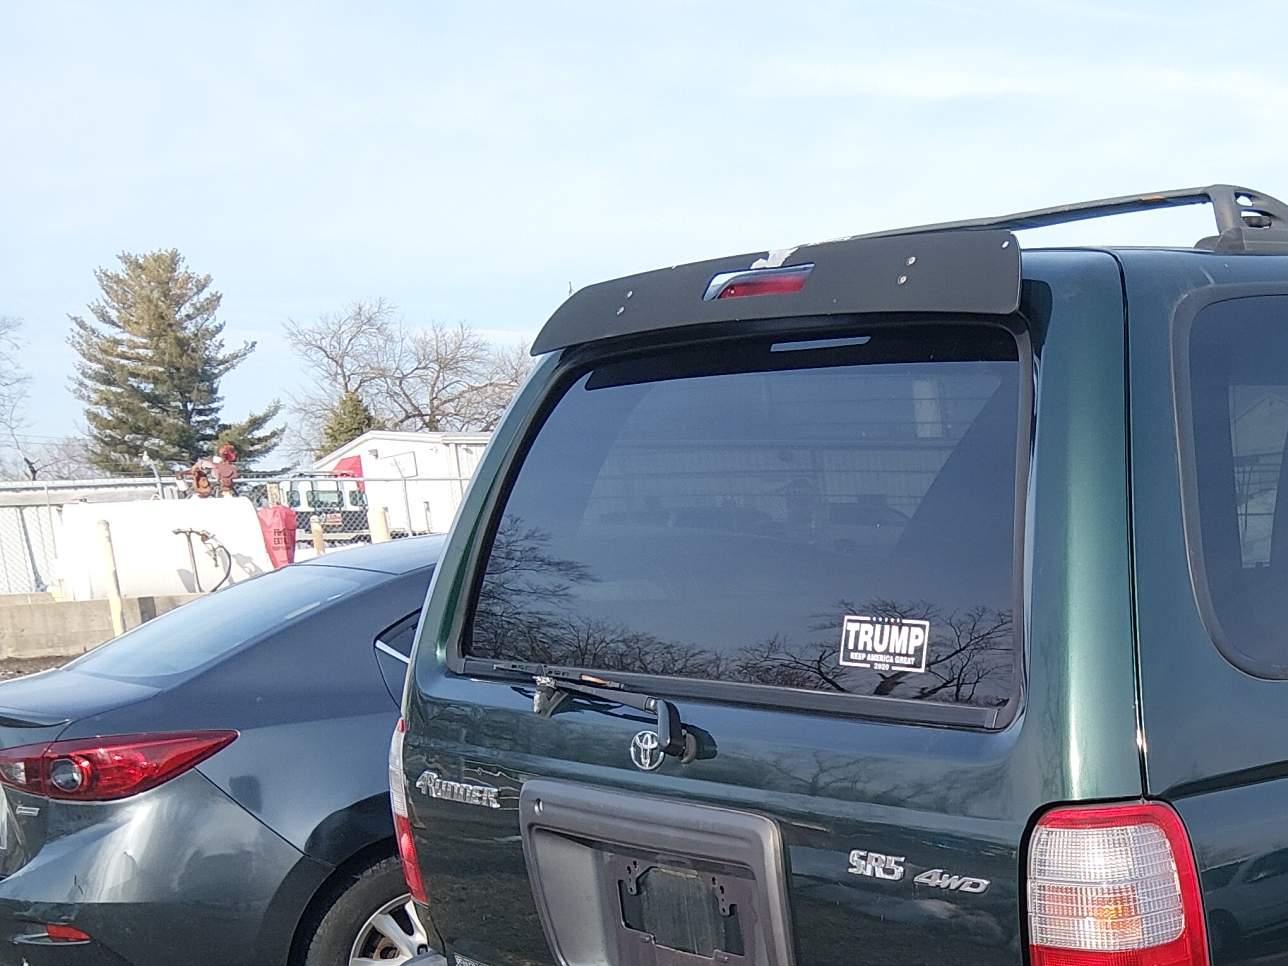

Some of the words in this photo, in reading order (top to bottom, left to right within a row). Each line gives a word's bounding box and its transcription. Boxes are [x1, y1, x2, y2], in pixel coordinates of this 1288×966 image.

[846, 622, 924, 655] TRUMP
[848, 849, 905, 881] SR5
[913, 868, 991, 893] 4WD
